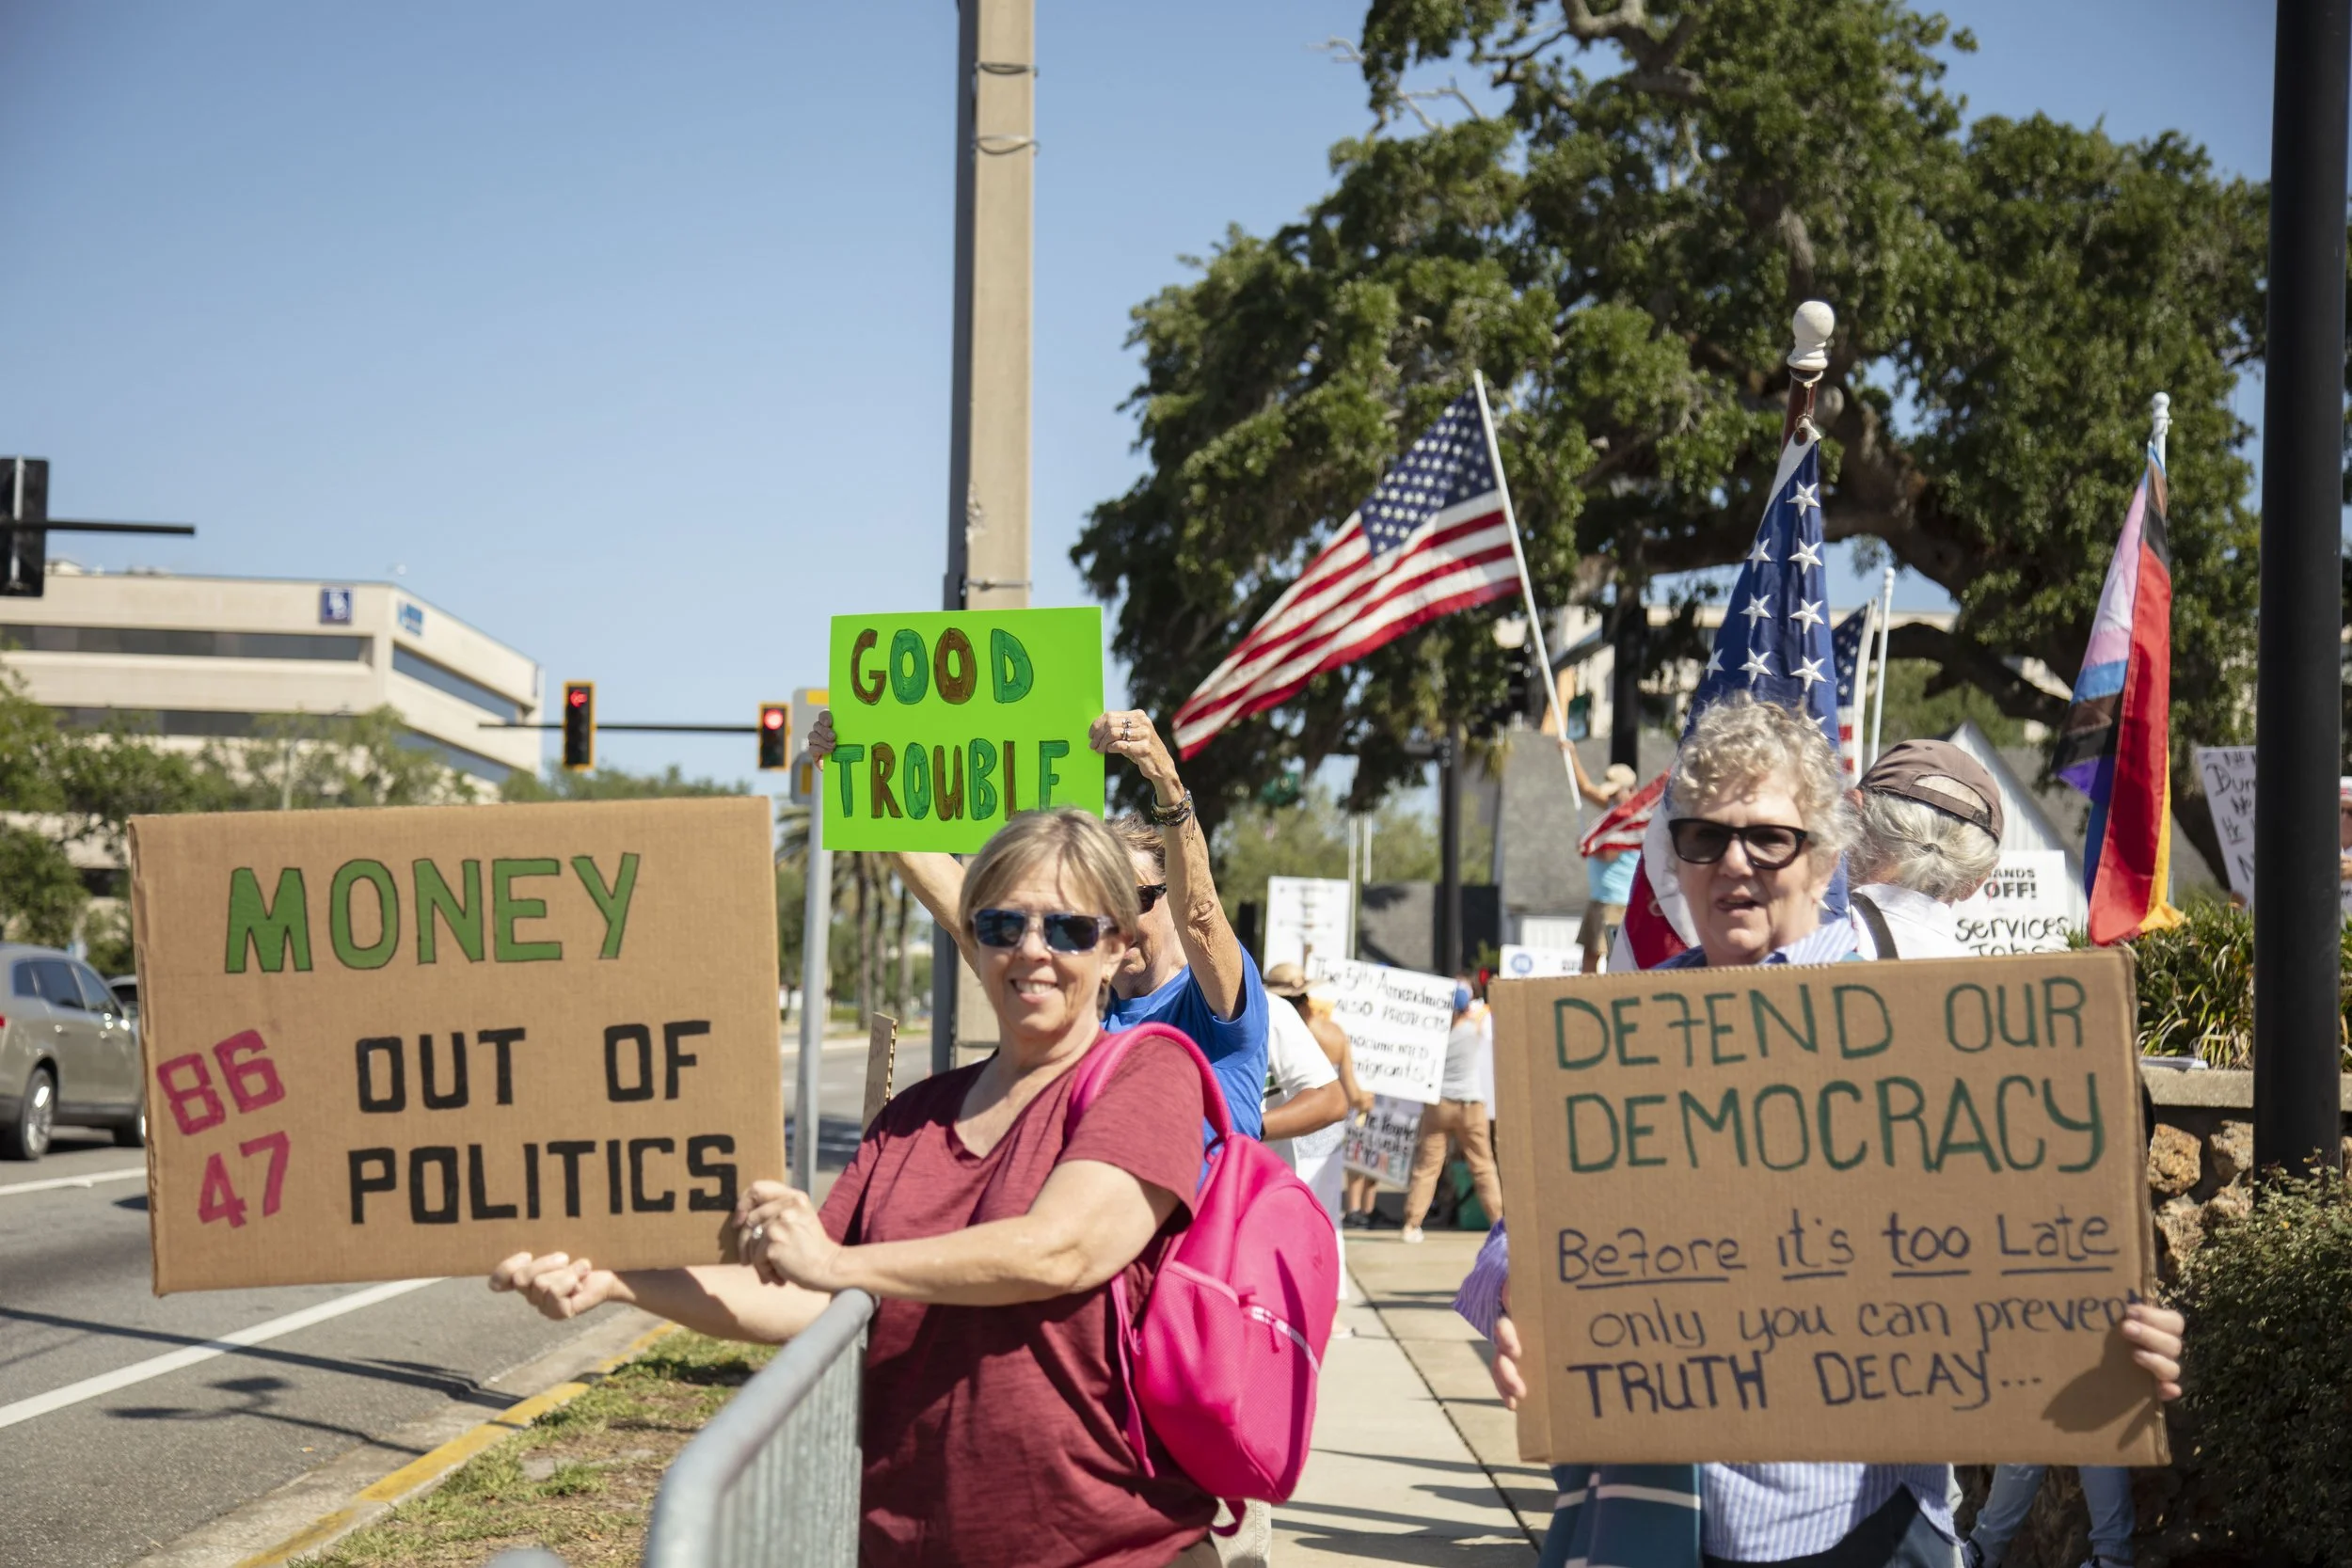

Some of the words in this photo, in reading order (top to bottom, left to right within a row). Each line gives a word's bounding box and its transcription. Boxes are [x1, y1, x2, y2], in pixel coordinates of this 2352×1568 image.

[850, 627, 1034, 705] GOOD
[831, 738, 1070, 821] TROUBLE
[224, 852, 640, 974] MONEY
[1983, 881, 2037, 899] OFF!
[1945, 977, 2087, 1053] OUR
[155, 1029, 286, 1136] 86
[356, 1027, 526, 1113] OUT
[603, 1020, 711, 1102] OF
[1566, 1073, 2106, 1172] DEMOCRACY
[198, 1131, 292, 1228] 47
[348, 1134, 739, 1225] POLITICS
[1778, 1209, 1854, 1268] it's
[1883, 1212, 1970, 1268] too
[1997, 1209, 2119, 1261] Late
[1590, 1299, 1706, 1348] only
[1739, 1302, 1834, 1353] you
[1859, 1299, 1950, 1335] can
[1567, 1351, 1768, 1418] TRUTH
[1816, 1351, 2042, 1410] DECAY...
